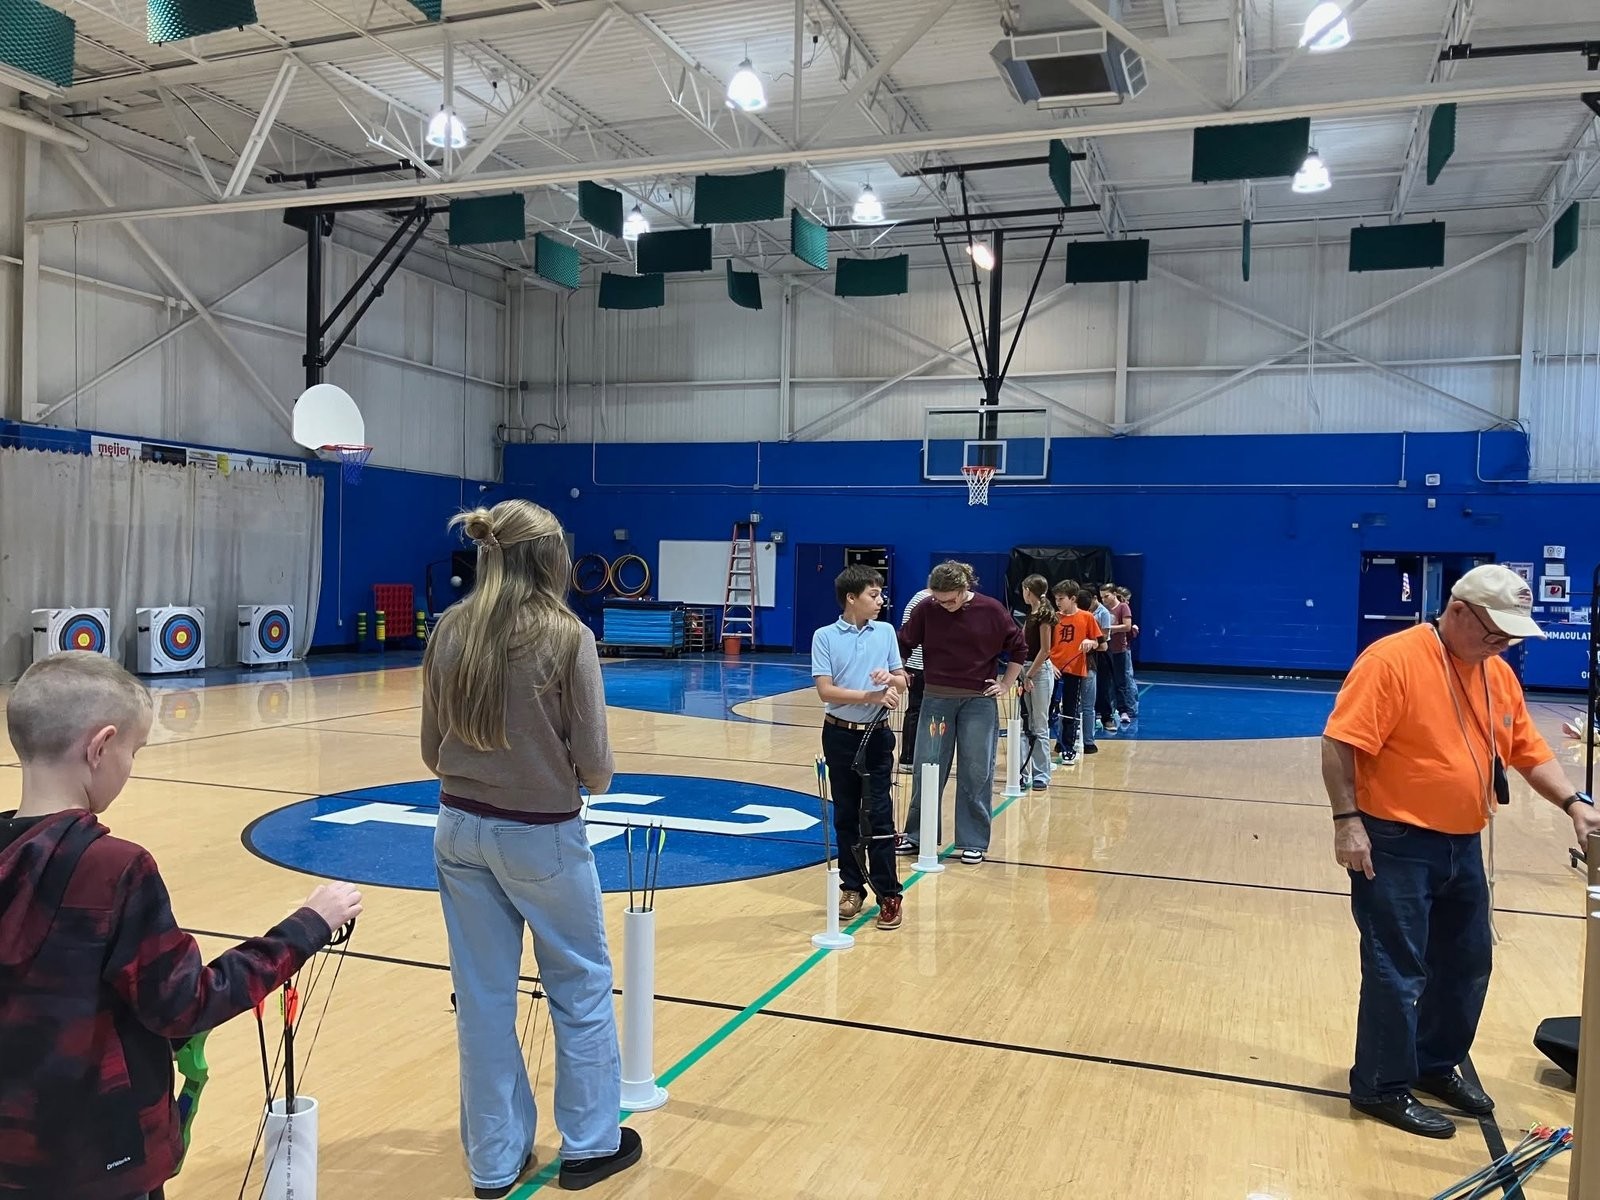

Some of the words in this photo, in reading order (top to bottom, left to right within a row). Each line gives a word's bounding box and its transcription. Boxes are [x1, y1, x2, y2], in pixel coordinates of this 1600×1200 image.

[98, 443, 131, 455] meijer
[1060, 623, 1075, 643] D
[1543, 631, 1591, 640] MMACULAT
